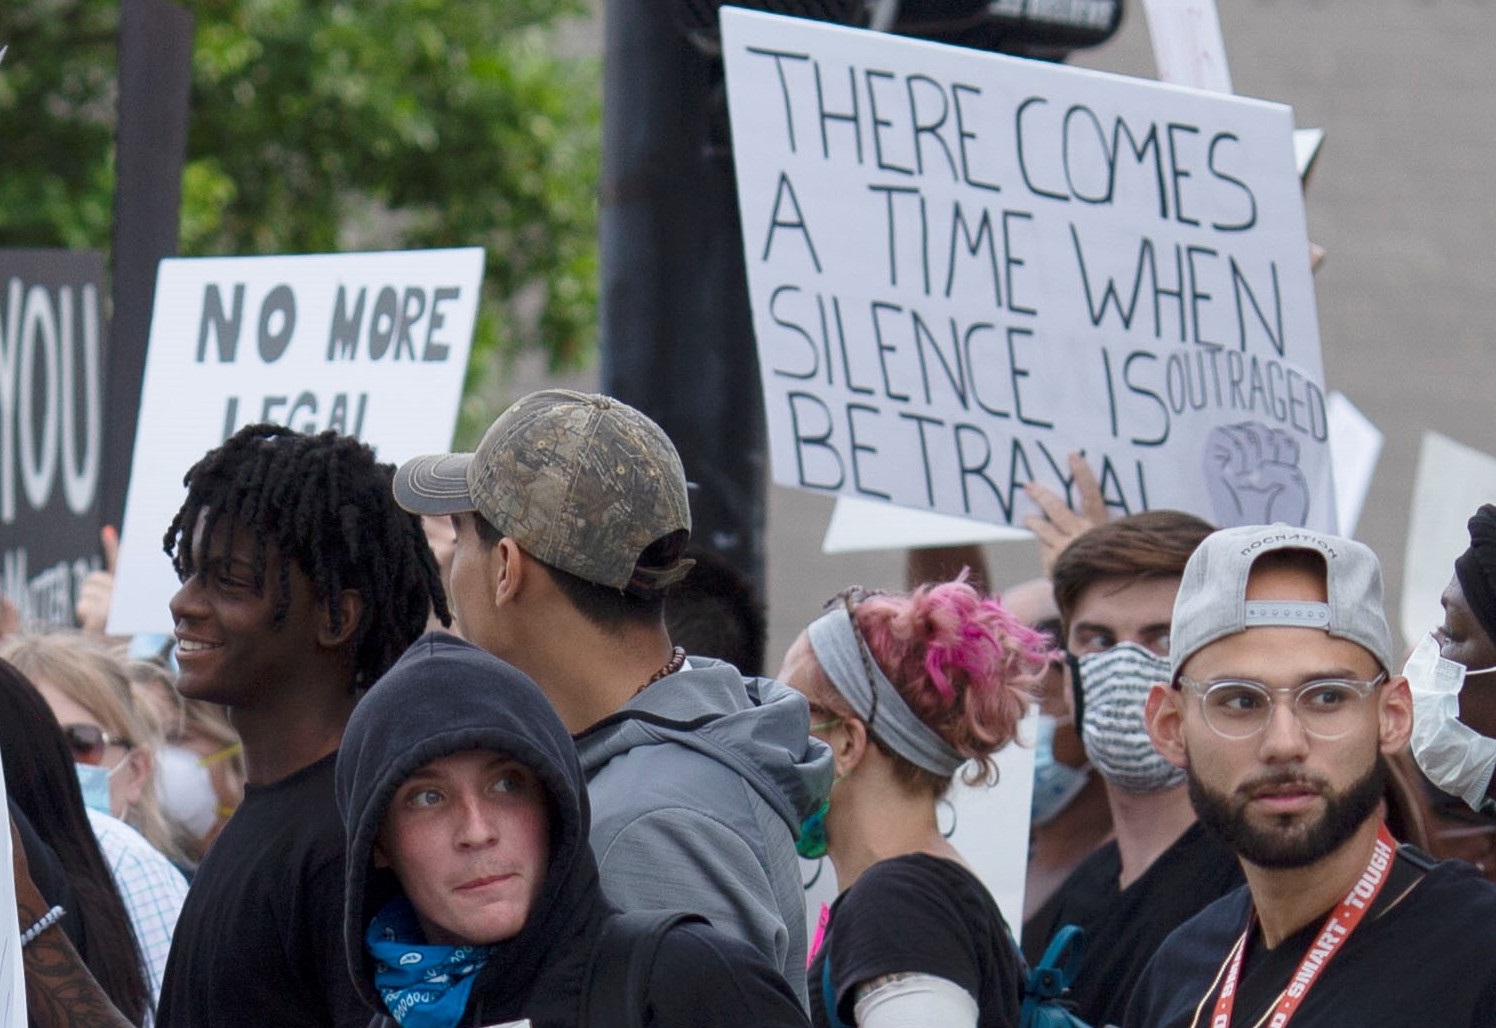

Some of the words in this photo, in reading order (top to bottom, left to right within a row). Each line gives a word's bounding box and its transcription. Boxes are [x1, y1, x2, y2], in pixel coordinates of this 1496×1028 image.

[746, 46, 1001, 193] THERE
[1015, 95, 1258, 232] COMES
[194, 282, 298, 364] NO
[325, 277, 461, 363] MORE
[762, 170, 822, 274] A
[868, 184, 1037, 316] TIME
[1070, 222, 1285, 357] WHEN
[769, 284, 1053, 429] SILENCE
[1103, 346, 1172, 447] IS
[1166, 343, 1329, 443] OUTRAGED
[1287, 919, 1348, 999] SMART
[1344, 838, 1392, 910] TOUGH
